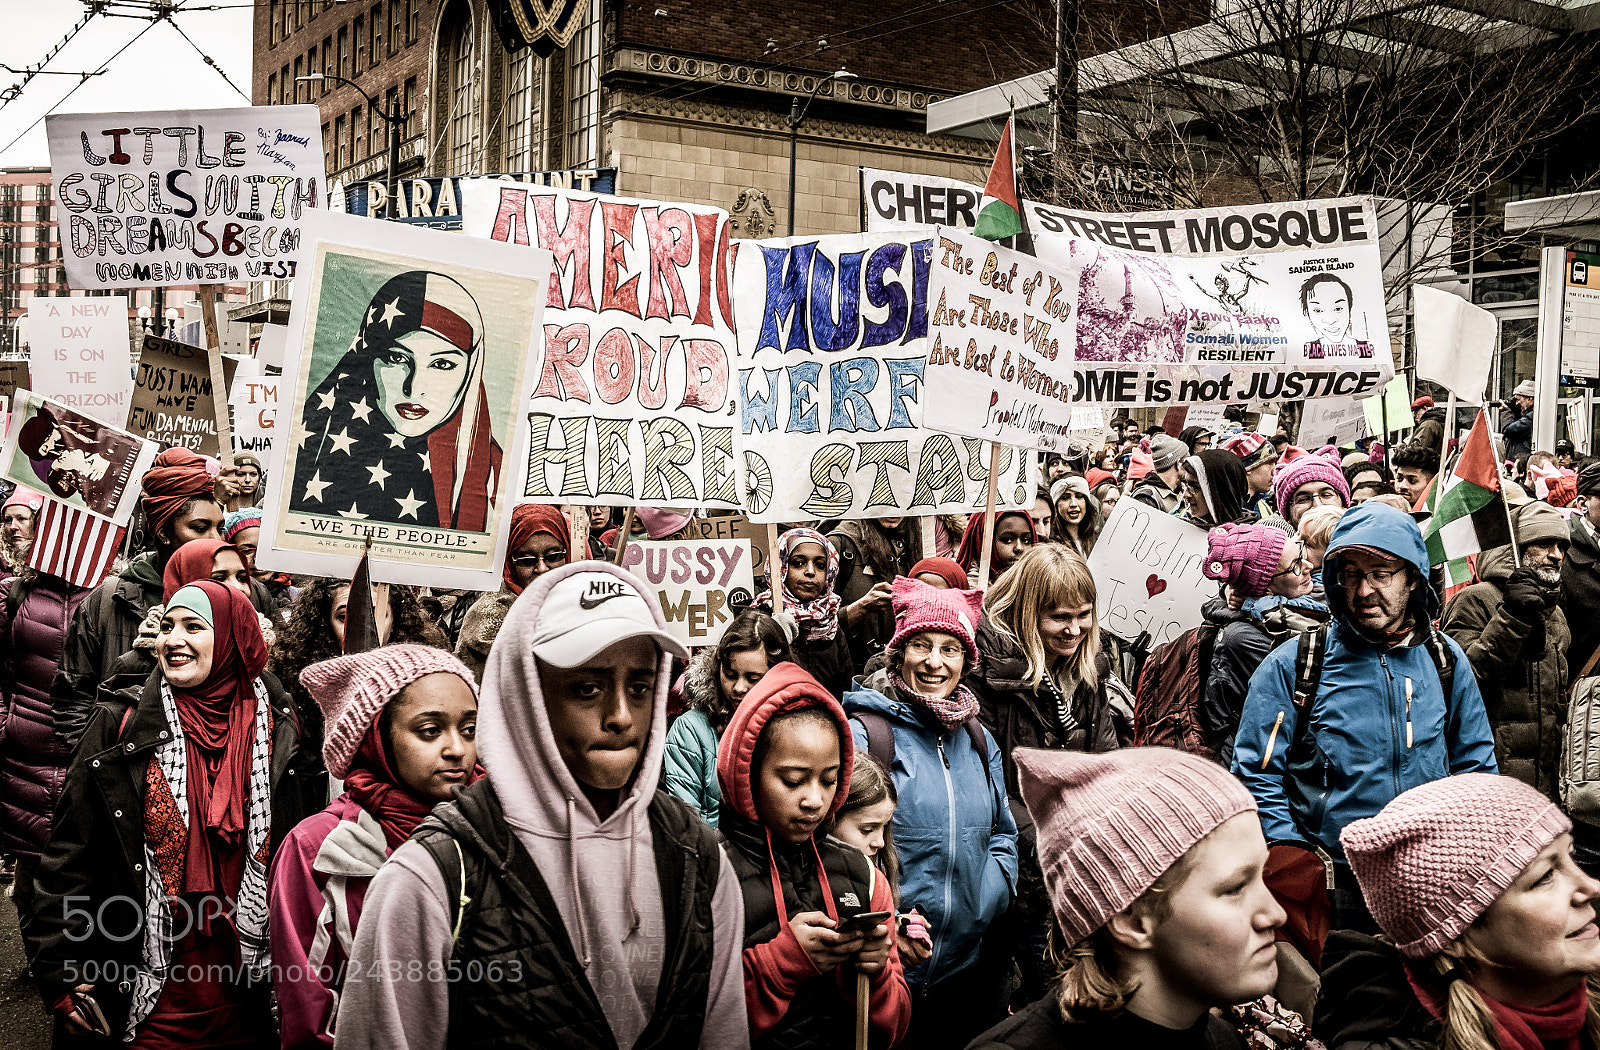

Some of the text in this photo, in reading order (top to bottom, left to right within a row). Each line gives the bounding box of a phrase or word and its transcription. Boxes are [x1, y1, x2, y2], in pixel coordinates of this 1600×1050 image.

[81, 124, 246, 169] LITTLE
[59, 169, 319, 221] GIRLS WITH
[870, 180, 1368, 254] CHER STREET MOSQUE
[70, 214, 219, 258] DREAMS
[96, 260, 181, 282] WOMEN
[186, 260, 239, 281] WITH
[939, 236, 1071, 323] The Best of You
[1289, 262, 1355, 275] SANDRA BLAND
[72, 304, 109, 317] NEW
[61, 326, 92, 339] DAY
[932, 286, 1058, 362] Are Those Who
[144, 338, 194, 358] GIRLS
[1186, 333, 1288, 345] Somali Women
[54, 349, 104, 361] IS ON
[929, 331, 960, 366] Are
[963, 338, 997, 377] Best
[1000, 350, 1014, 382] to
[1198, 350, 1275, 361] RESILIENT
[1328, 344, 1347, 357] LIVES
[66, 371, 96, 384] THE
[137, 363, 178, 391] JUST
[1145, 372, 1172, 402] is
[1179, 374, 1233, 401] not
[1237, 371, 1381, 400] JUSTICE
[50, 389, 128, 406] ORIZON!'
[156, 395, 197, 412] HAVE
[246, 383, 277, 404] I'M
[131, 407, 217, 435] FUNDAMENTAL
[524, 411, 742, 506] HERE
[799, 434, 1028, 518] STAY!
[310, 519, 468, 547] WE THE PEOPLE
[317, 540, 338, 548] ARE
[397, 549, 425, 557] THAN
[621, 544, 744, 588] PUSSY
[588, 581, 625, 596] NIKE
[658, 590, 728, 637] WER
